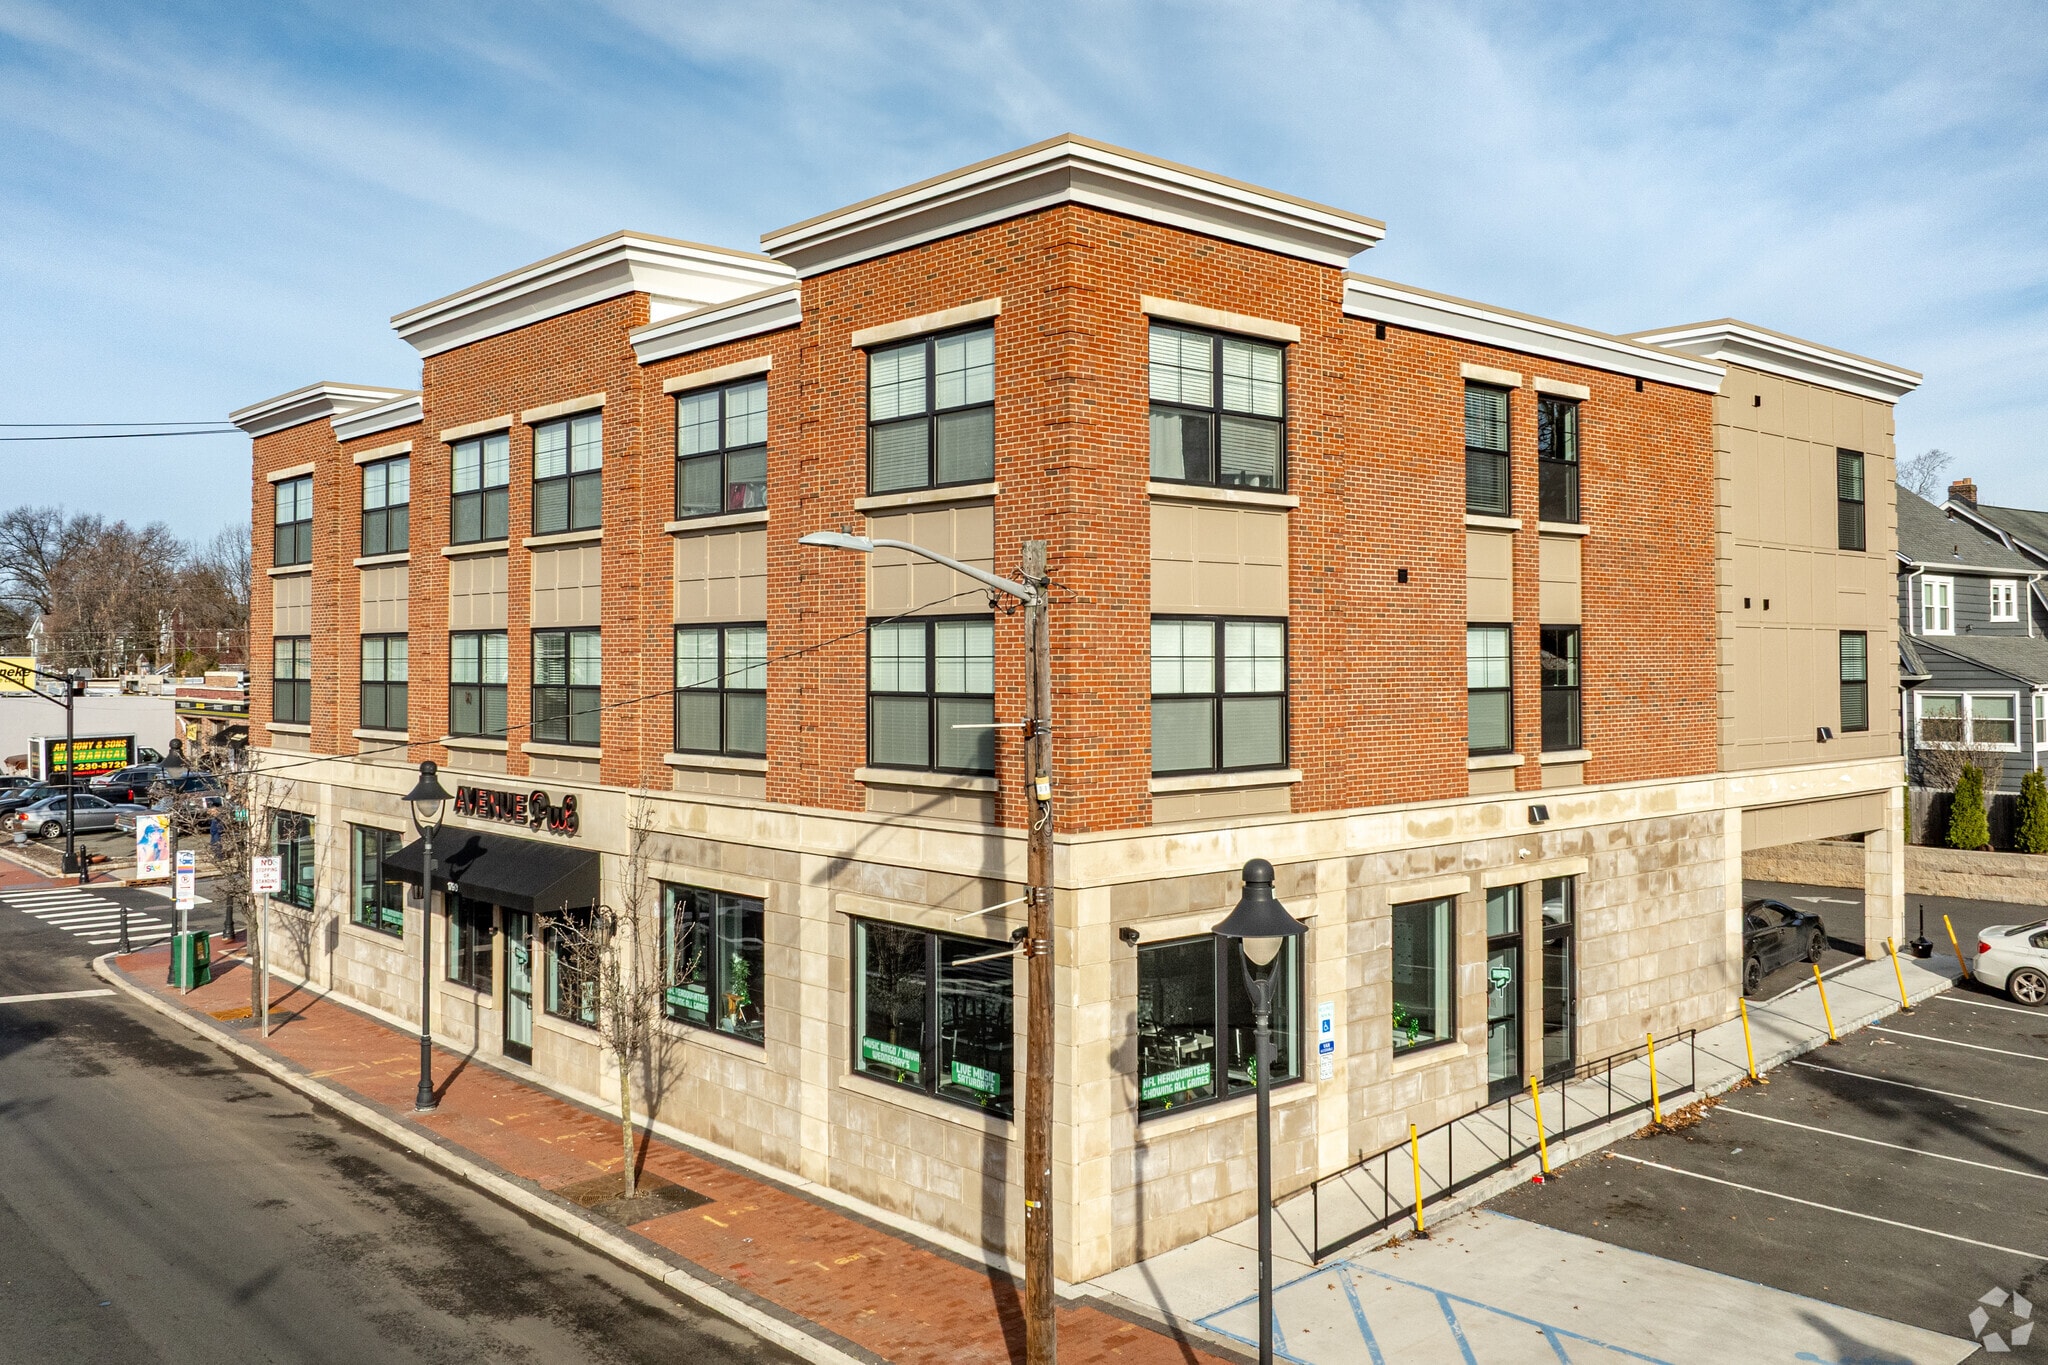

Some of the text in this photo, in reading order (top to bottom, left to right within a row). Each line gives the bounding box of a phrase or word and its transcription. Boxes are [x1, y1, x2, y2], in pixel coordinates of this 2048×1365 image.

[53, 740, 127, 752] ANHONY & SONS
[454, 786, 528, 824] AVENUE
[864, 1037, 880, 1051] MUSIC
[956, 1062, 996, 1083] LIVE MUSIC
[957, 1073, 994, 1092] SATURDAY'S
[1143, 1063, 1209, 1088] NFL HEADQUARTERS
[1143, 1075, 1209, 1101] SHOWING ALL GAMES
